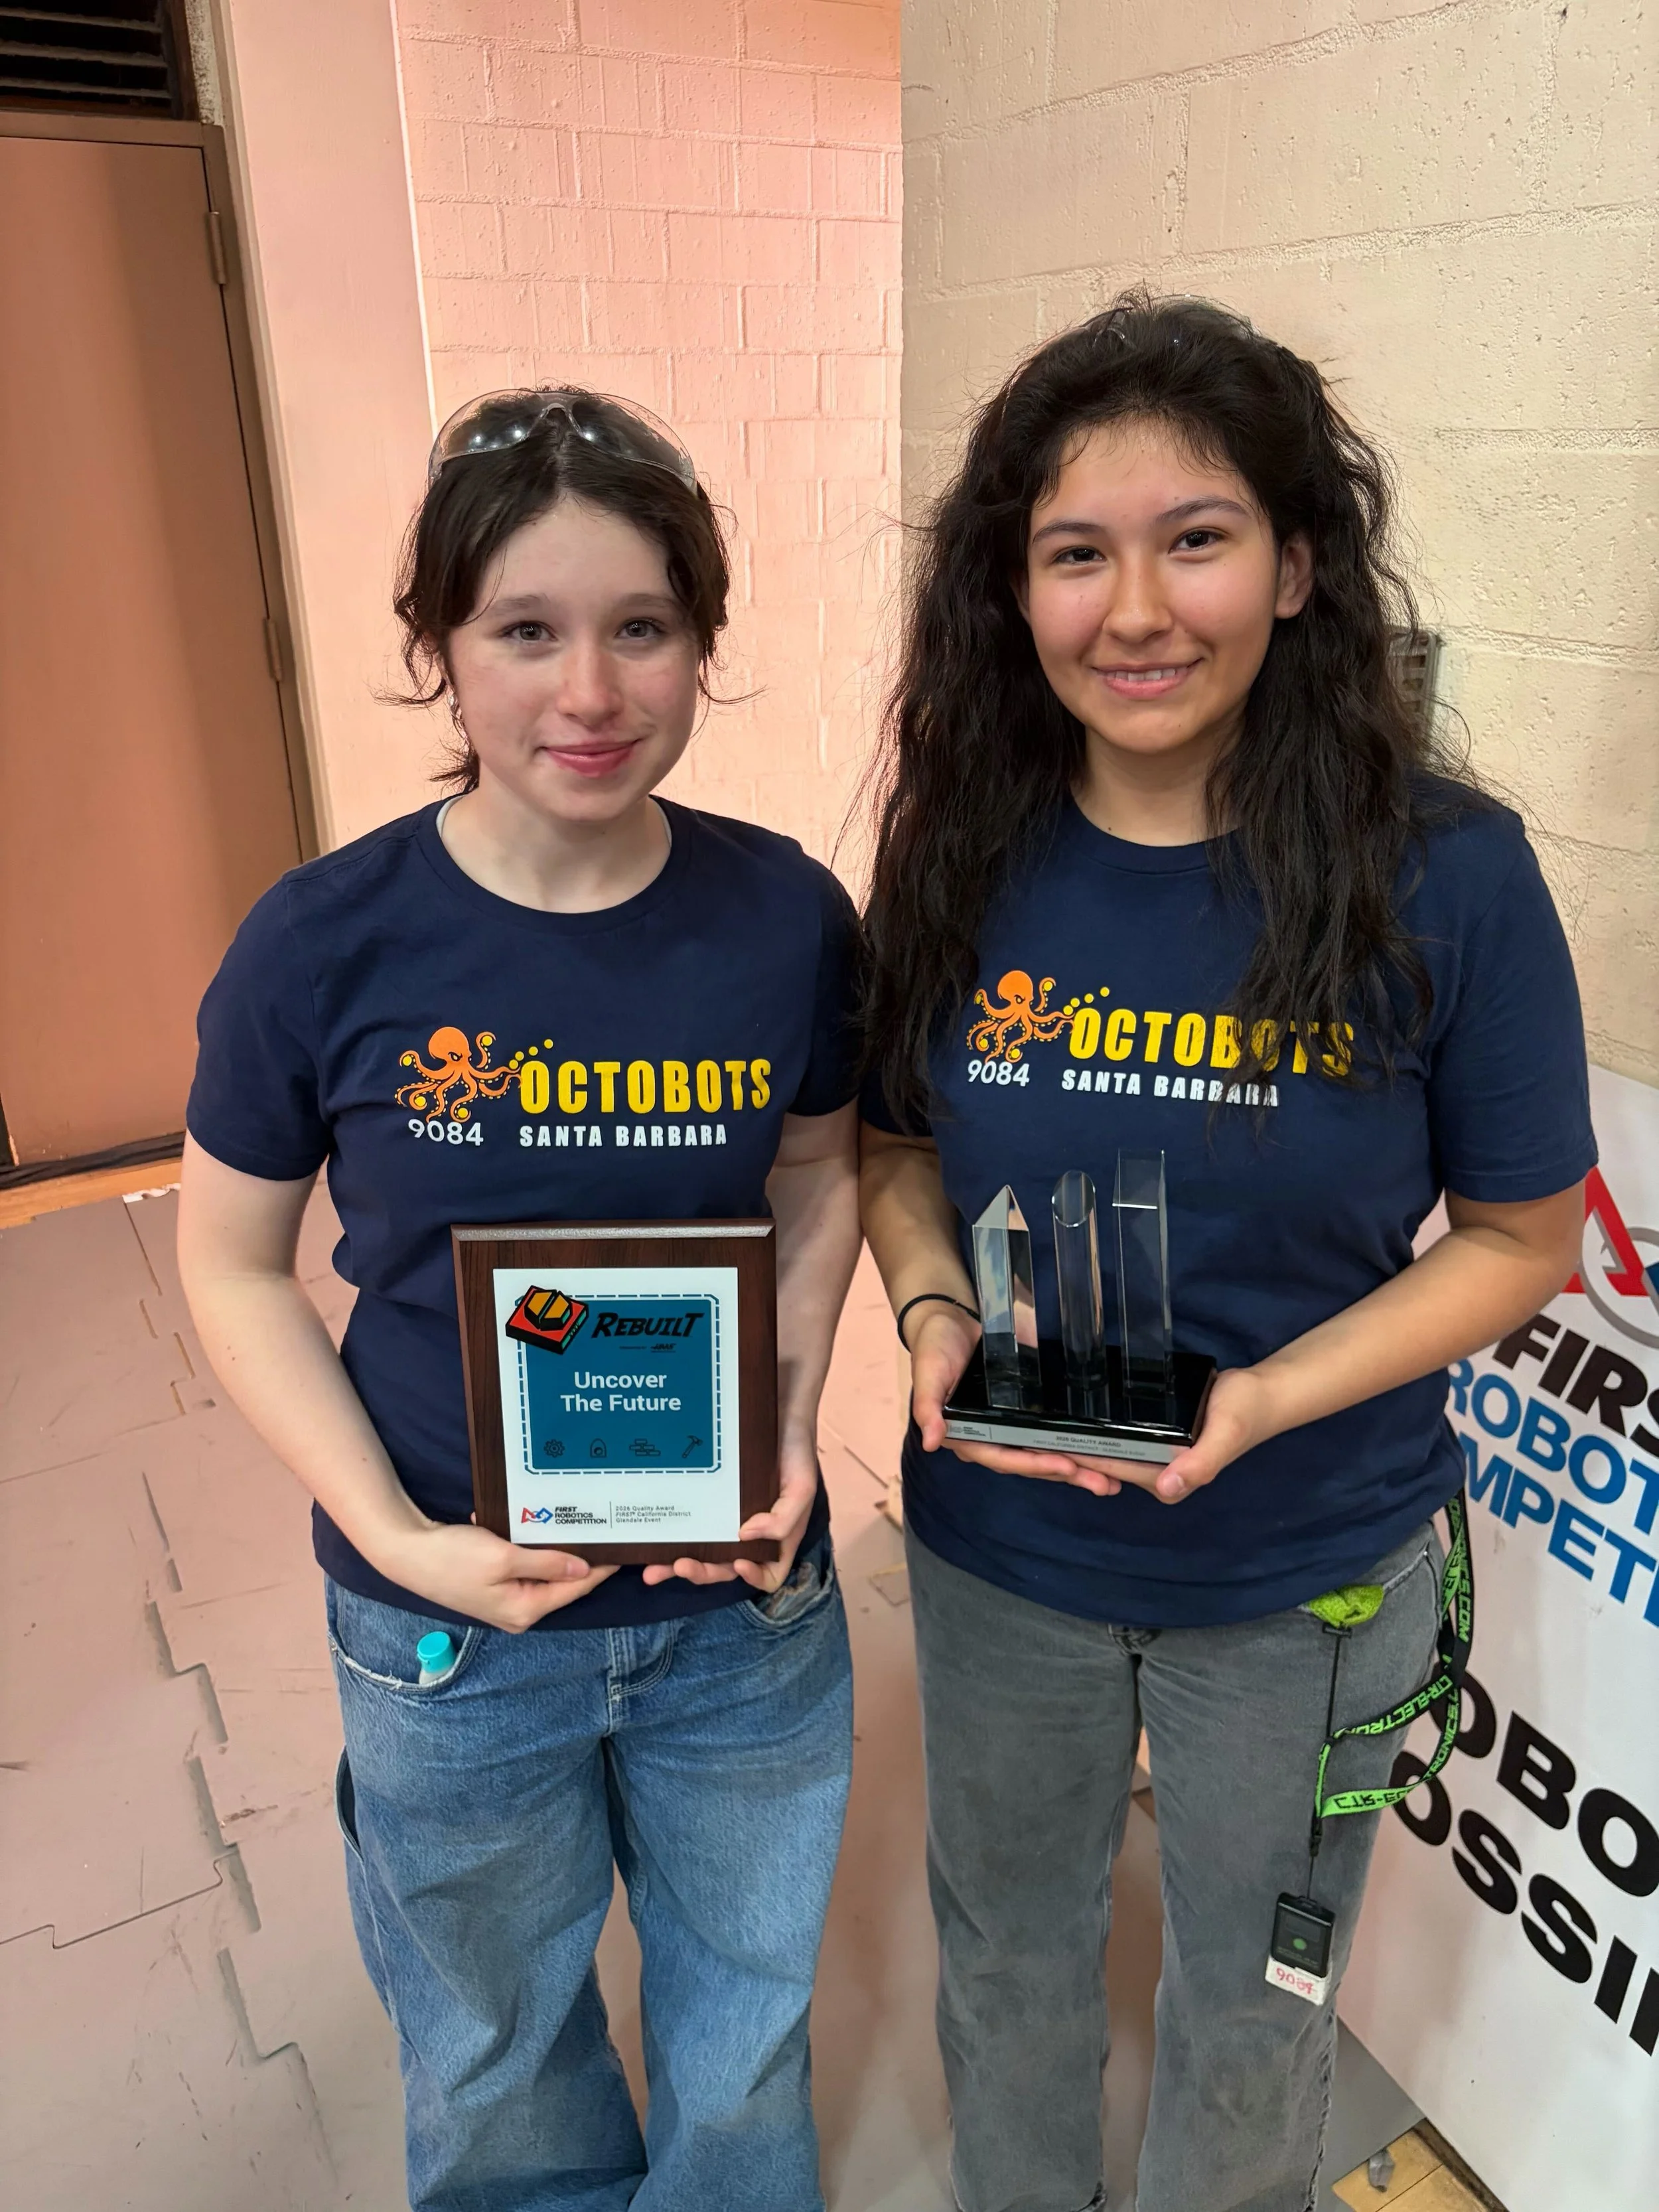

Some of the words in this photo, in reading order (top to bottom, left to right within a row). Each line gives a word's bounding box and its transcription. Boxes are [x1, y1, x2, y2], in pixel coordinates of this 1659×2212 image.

[520, 1059, 771, 1114] OCTOBOTS
[967, 1059, 1030, 1087] 9084
[1062, 1070, 1141, 1096] SANTA
[1153, 1074, 1279, 1107] BARBARA
[407, 1118, 484, 1147] 9084
[520, 1124, 603, 1147] SANTA
[616, 1124, 727, 1147] BARBARA
[591, 1312, 705, 1339] REBUILT
[574, 1371, 667, 1389] Uncover
[560, 1394, 603, 1412] The
[609, 1394, 682, 1412] Future
